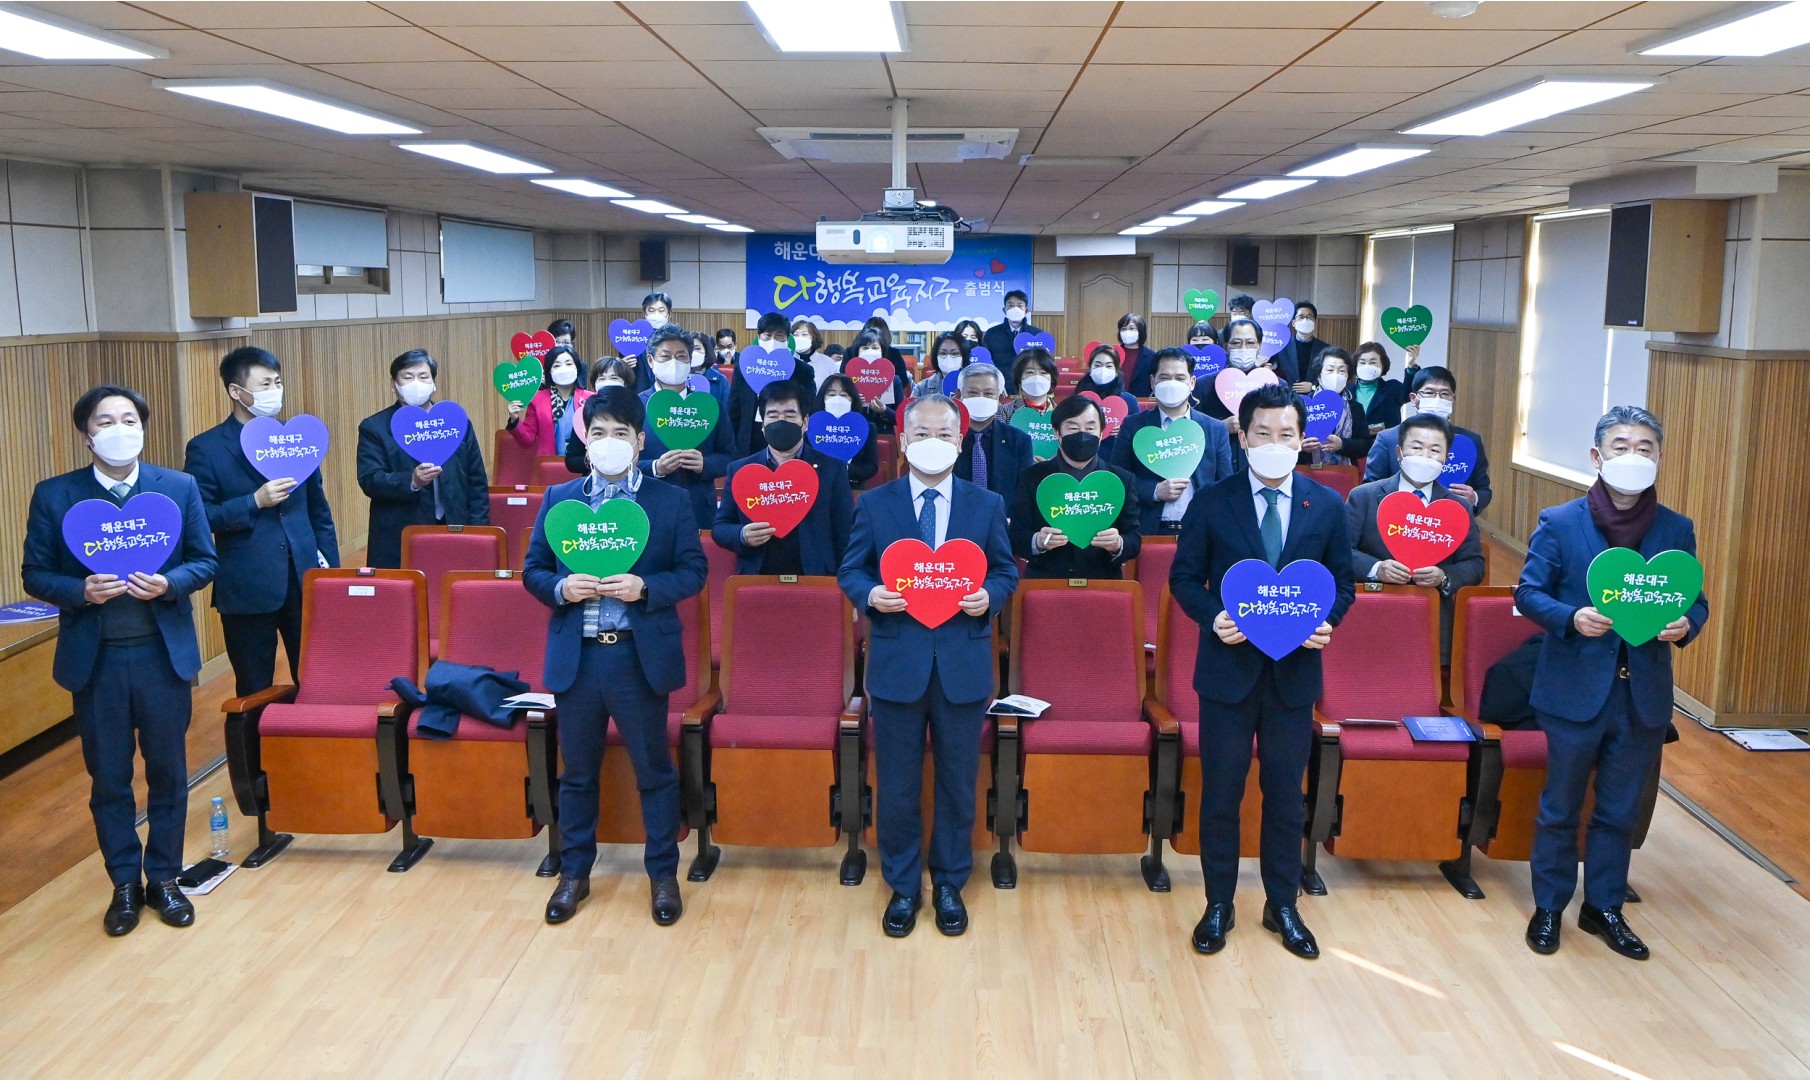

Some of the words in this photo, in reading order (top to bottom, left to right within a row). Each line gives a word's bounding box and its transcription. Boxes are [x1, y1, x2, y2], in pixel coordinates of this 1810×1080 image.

[773, 270, 960, 311] 다행복교육지구
[963, 281, 1006, 297] 출범식
[756, 358, 779, 367] 해운대구
[508, 370, 528, 379] 해운대구
[746, 366, 788, 380] 다행복교육지구
[852, 375, 889, 386] 다행복교육지구
[669, 406, 699, 416] 해운대구
[415, 418, 446, 429] 해운대구
[656, 416, 710, 430] 다행복교육지구
[825, 425, 851, 434] 해운대구
[269, 434, 304, 444] 해운대구
[404, 427, 461, 446] 다행복교육지구
[815, 434, 861, 446] 다행복교육지구
[1155, 435, 1184, 448] 해운대구
[256, 445, 320, 462] 다행복교육지구
[1147, 443, 1200, 464] 다행복교육지구
[759, 480, 794, 491] 해운대구
[746, 491, 810, 510] 다행복교육지구
[1064, 491, 1099, 502] 해운대구
[1050, 503, 1116, 519] 다행복교육지구
[100, 518, 148, 535] 해운대구
[577, 522, 619, 534] 해운대구
[1406, 513, 1442, 529] 해운대구
[1387, 524, 1455, 548] 다행복교육지구
[83, 531, 171, 557] 다행복교육지구
[561, 537, 638, 554] 다행복교육지구
[914, 562, 956, 574] 해운대구
[896, 575, 974, 592] 다행복교육지구
[1623, 573, 1669, 587] 해운대구
[1257, 585, 1302, 597] 해운대구
[1602, 588, 1687, 608] 다행복교육지구
[1238, 600, 1322, 618] 다행복교육지구
